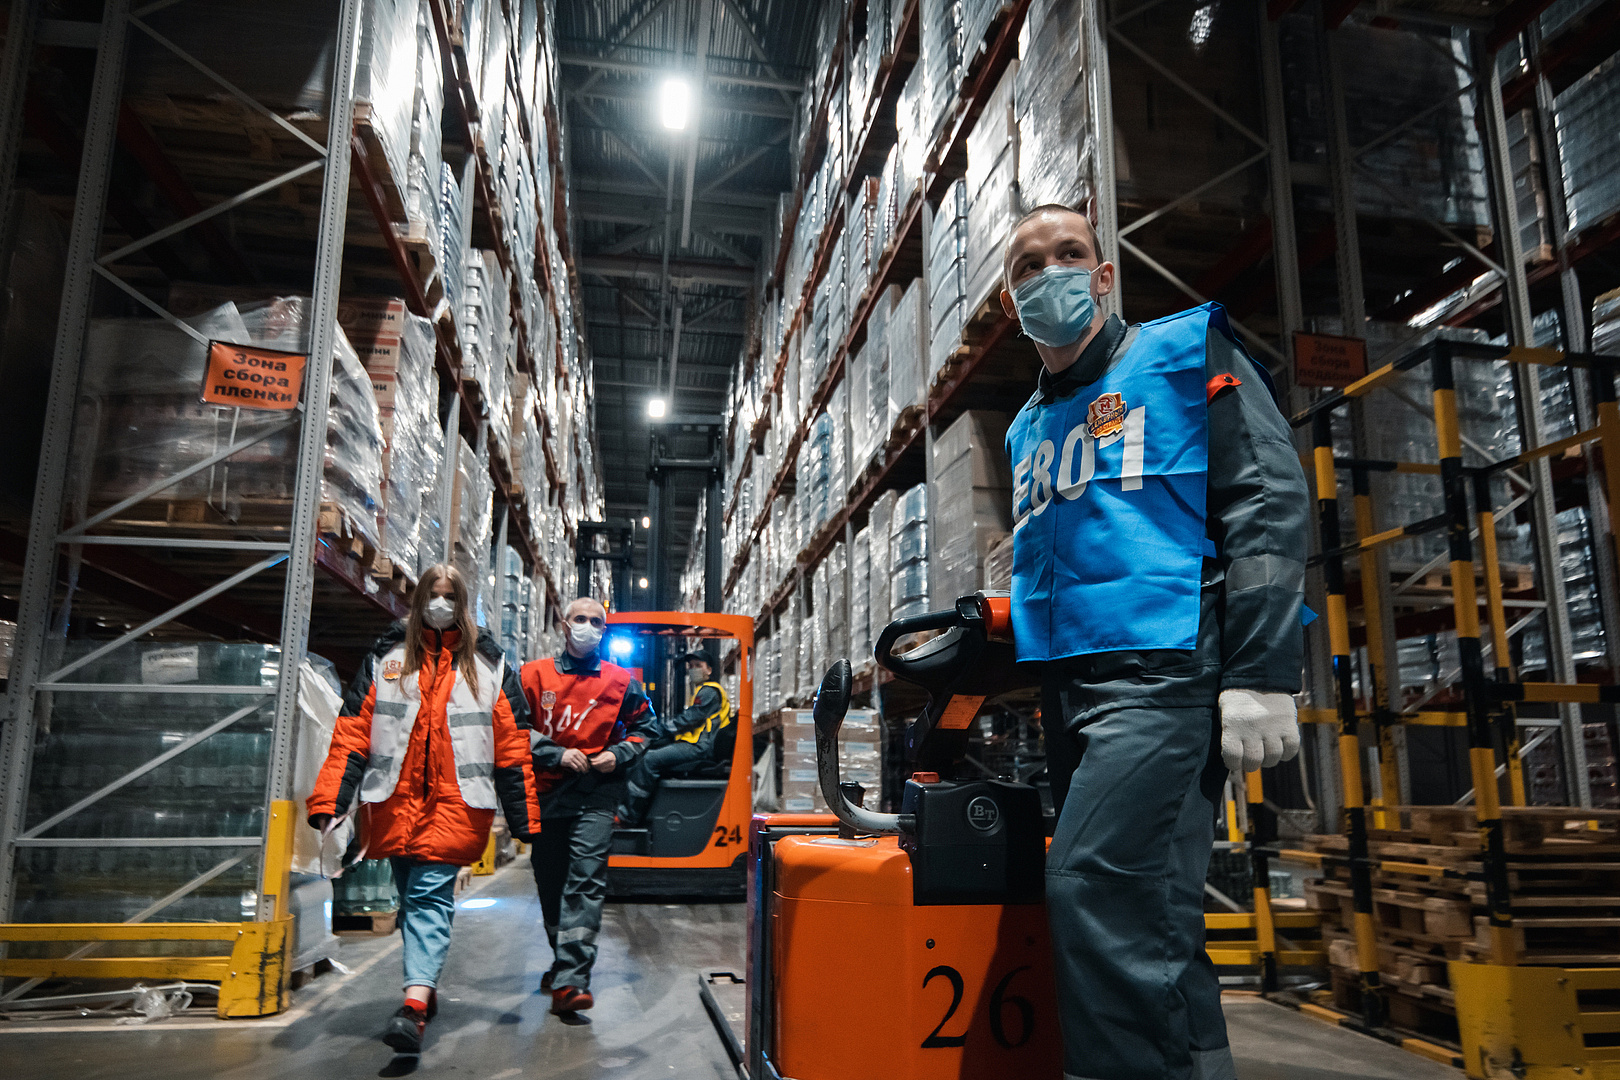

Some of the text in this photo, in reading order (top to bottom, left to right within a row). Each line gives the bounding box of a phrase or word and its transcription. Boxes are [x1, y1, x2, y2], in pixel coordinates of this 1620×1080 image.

[232, 352, 288, 372] Зона
[223, 368, 290, 388] сбора
[213, 384, 293, 403] пленки
[1013, 405, 1146, 533] E801
[973, 804, 996, 821] BT
[714, 825, 743, 848] 24
[920, 964, 1035, 1050] 26
